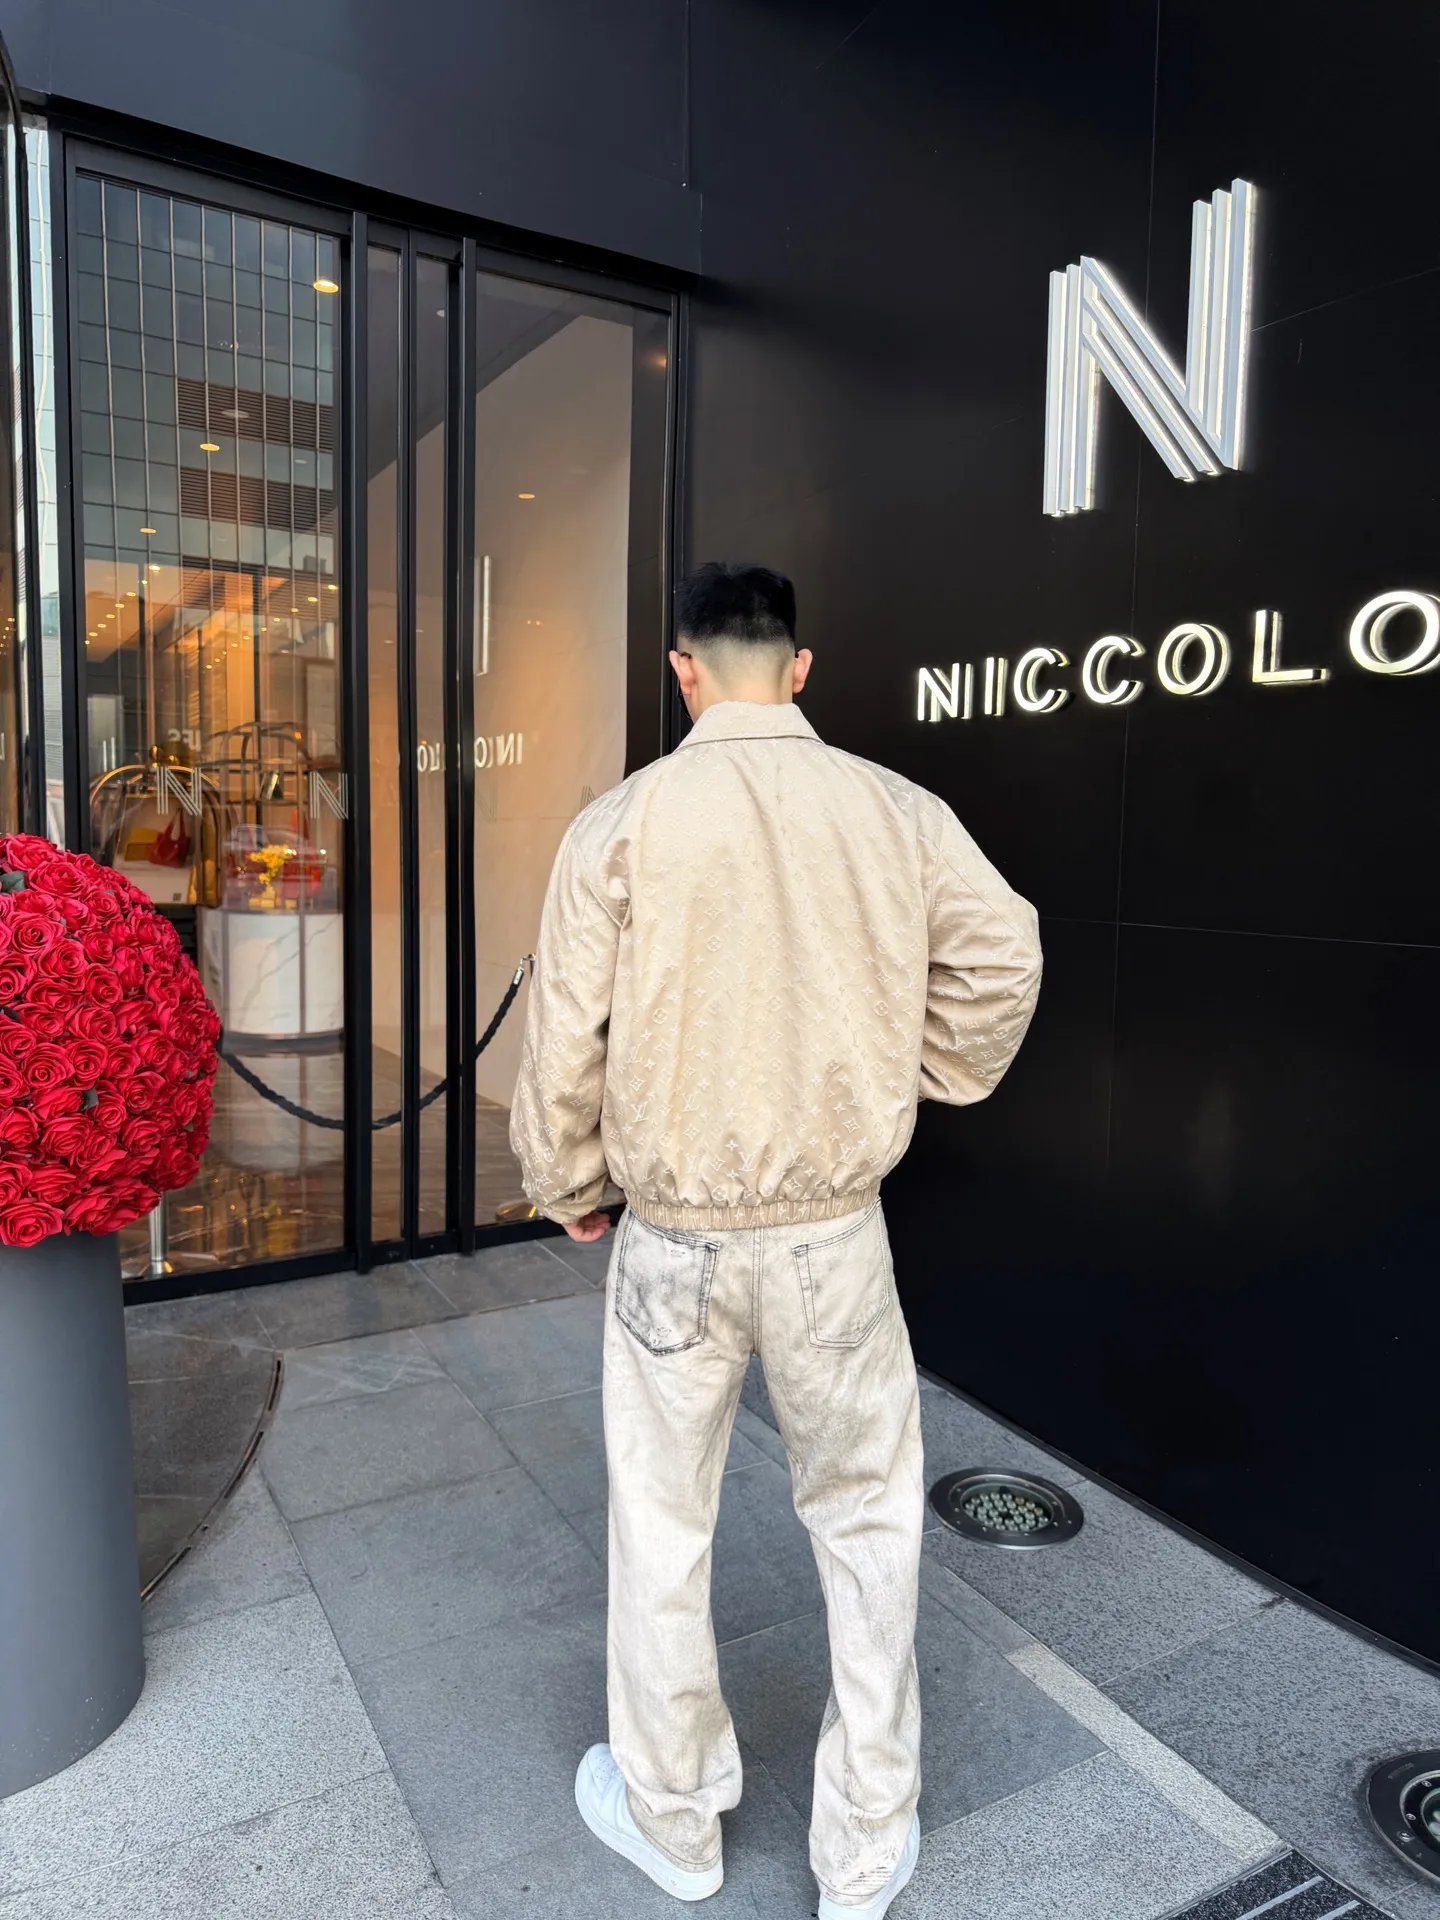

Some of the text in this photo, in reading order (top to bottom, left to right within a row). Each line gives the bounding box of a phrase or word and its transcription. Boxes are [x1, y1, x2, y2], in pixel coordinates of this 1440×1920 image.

[1042, 177, 1254, 518] N
[916, 590, 1440, 722] NICCOLO
[156, 766, 203, 816] N
[309, 771, 349, 820] N
